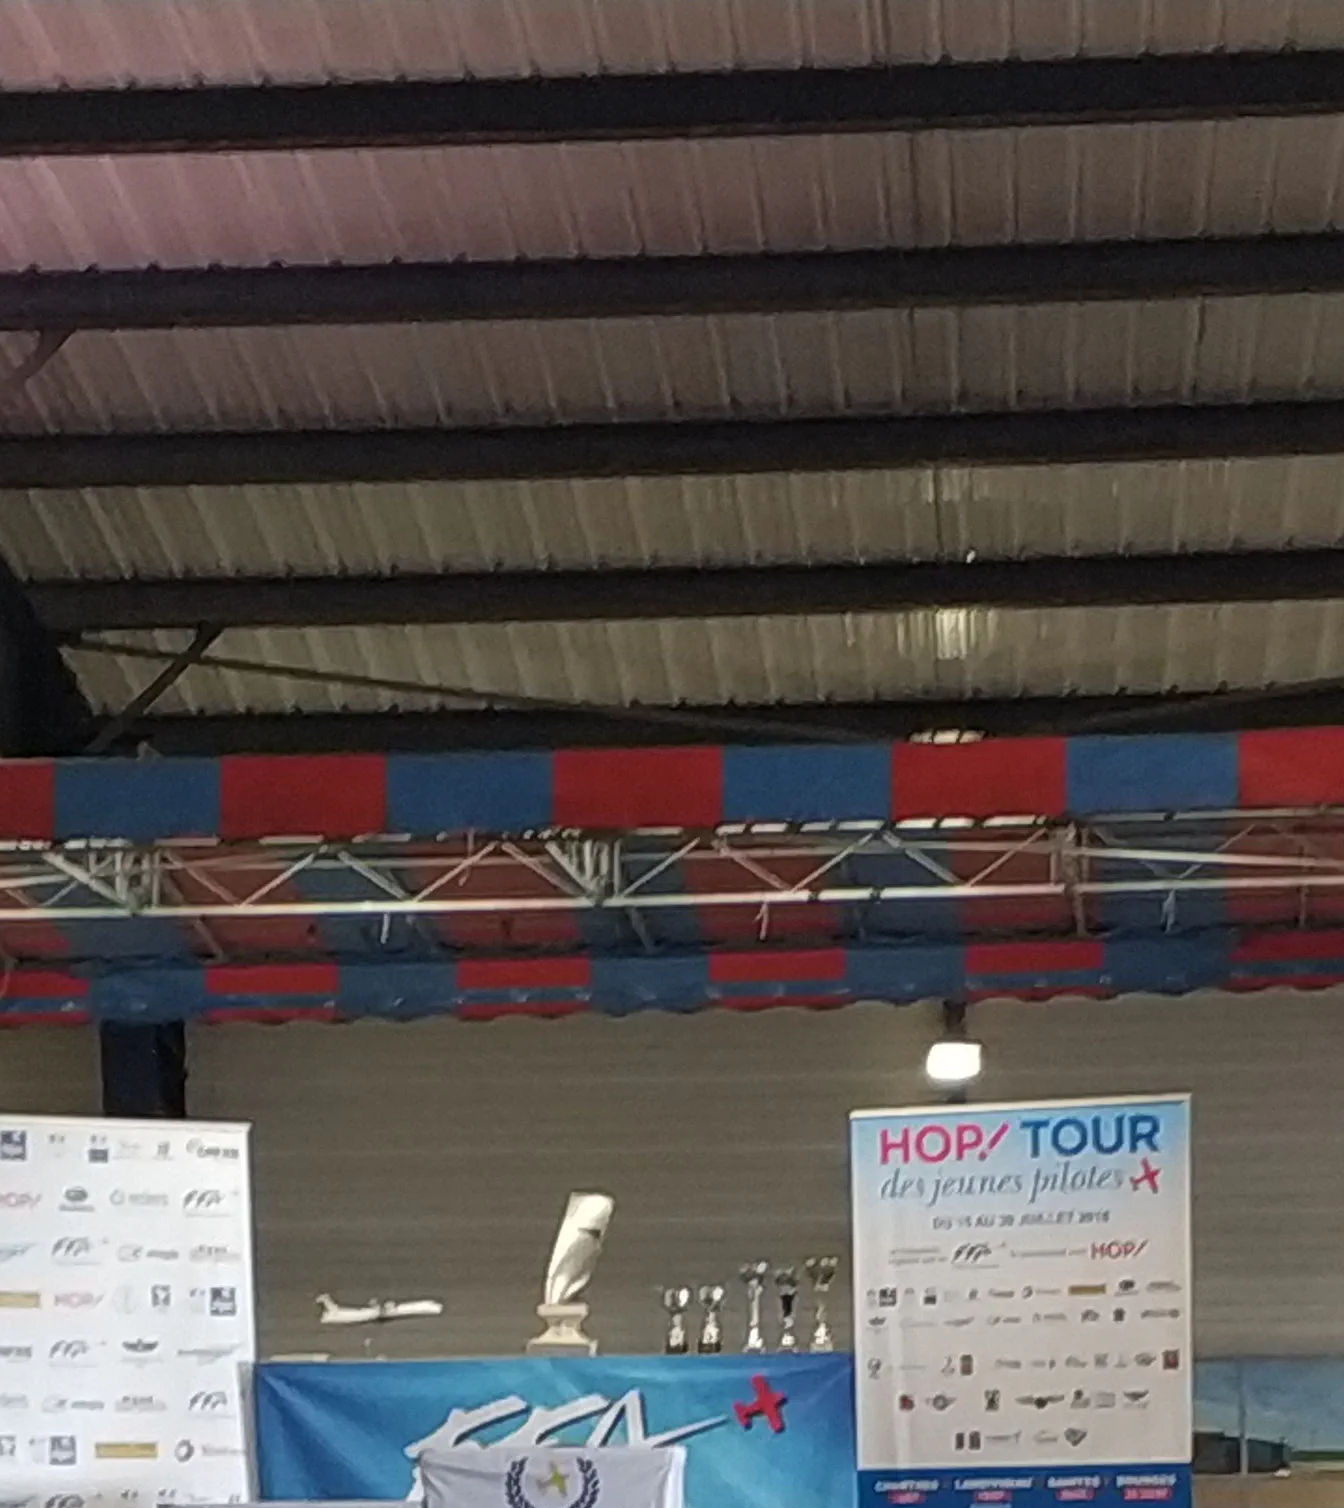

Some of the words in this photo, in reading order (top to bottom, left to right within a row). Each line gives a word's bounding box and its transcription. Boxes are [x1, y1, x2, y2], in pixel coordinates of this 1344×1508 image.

[879, 1122, 1009, 1165] HOP!
[1020, 1114, 1161, 1158] TOUR
[881, 1167, 924, 1198] des
[926, 1169, 1023, 1207] jeunes
[1028, 1160, 1122, 1203] pilotes
